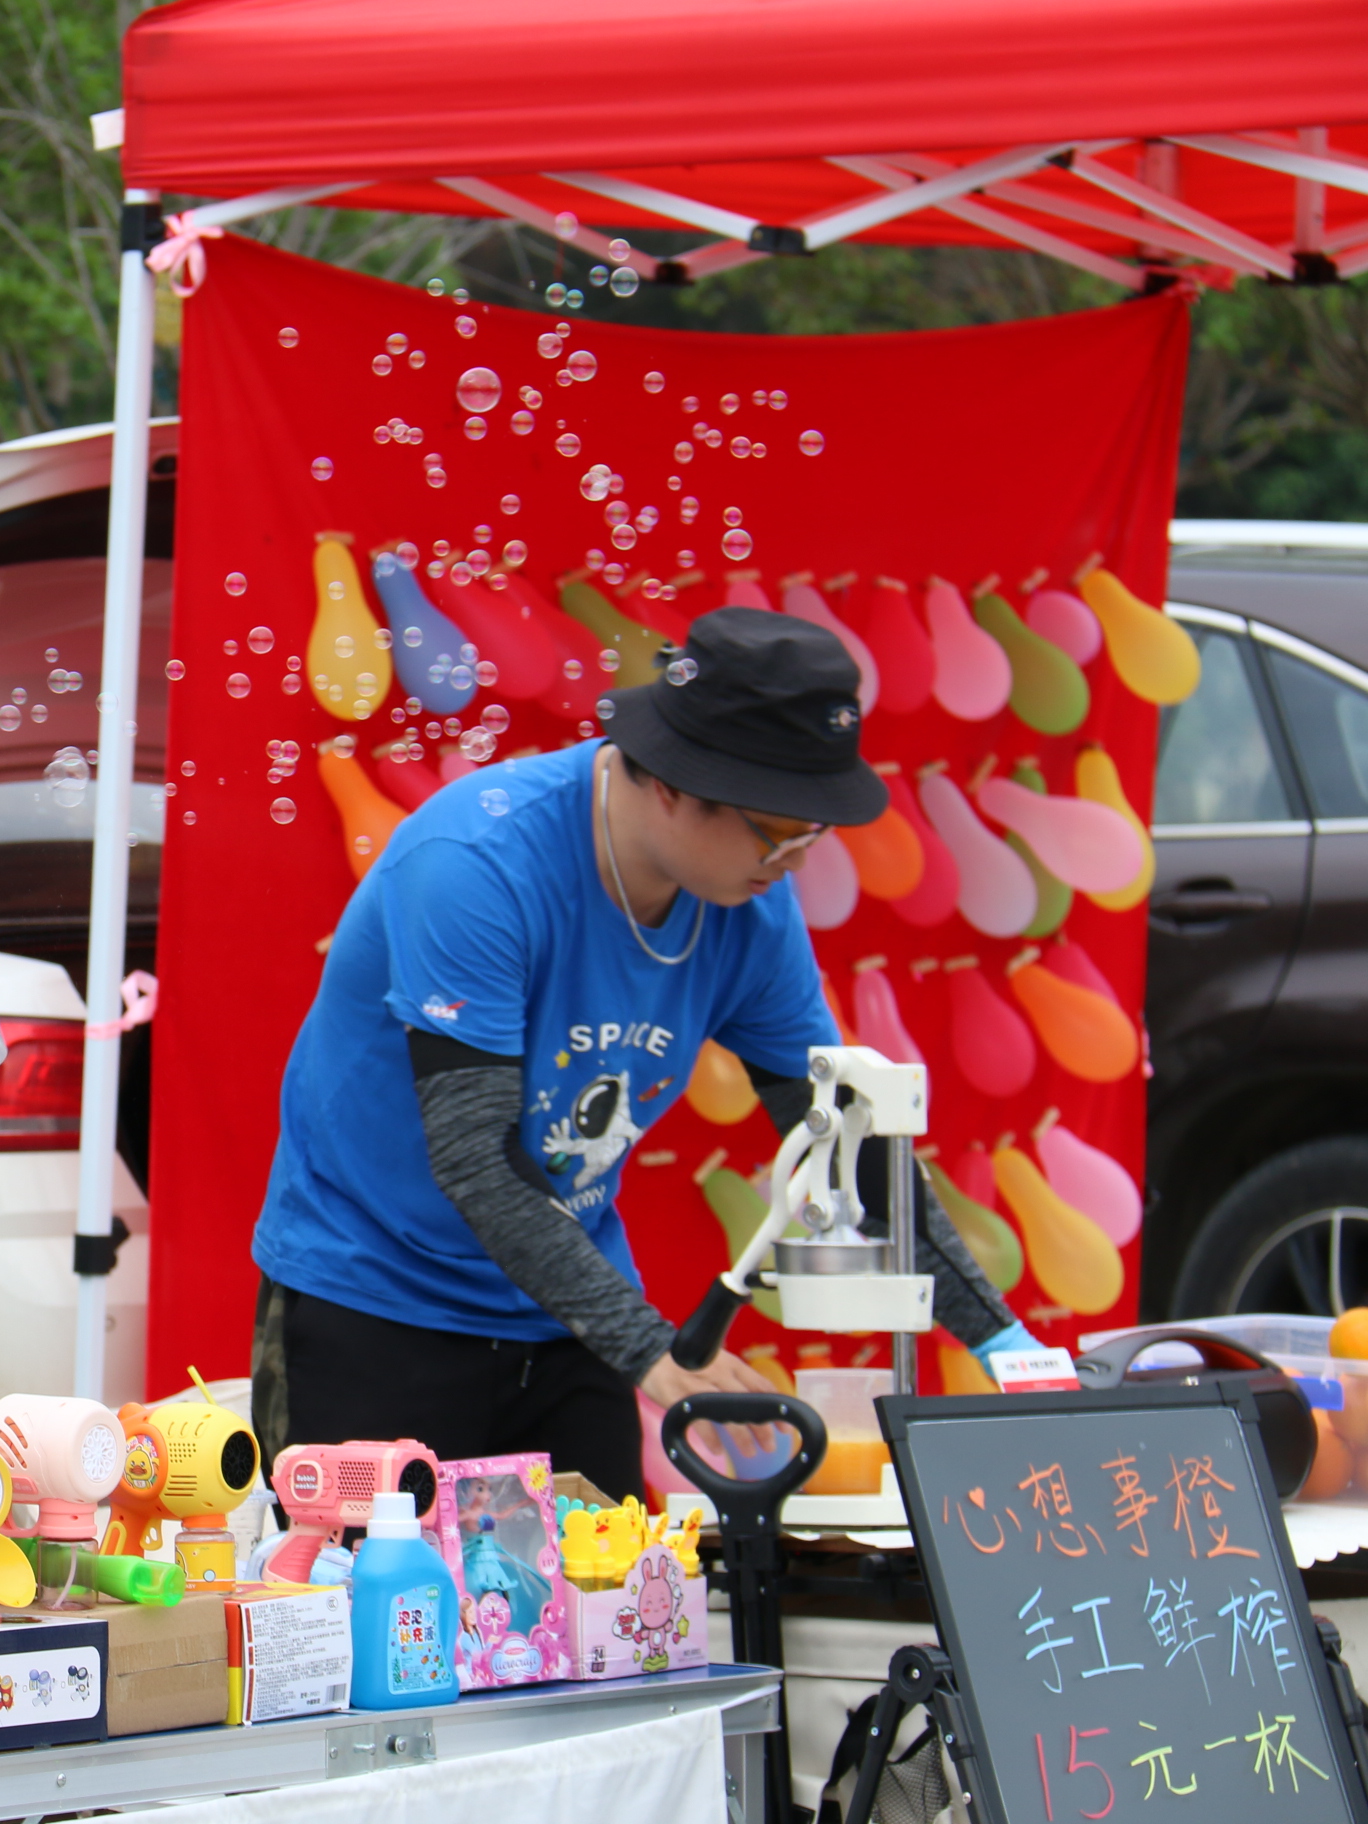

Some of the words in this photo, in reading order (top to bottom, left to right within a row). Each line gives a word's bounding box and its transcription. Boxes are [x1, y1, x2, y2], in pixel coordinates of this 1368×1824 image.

[942, 1448, 1260, 1560] 心想事橙
[1018, 1576, 1296, 1705] 手工鲜榨
[1036, 1711, 1330, 1822] 15元一杯
